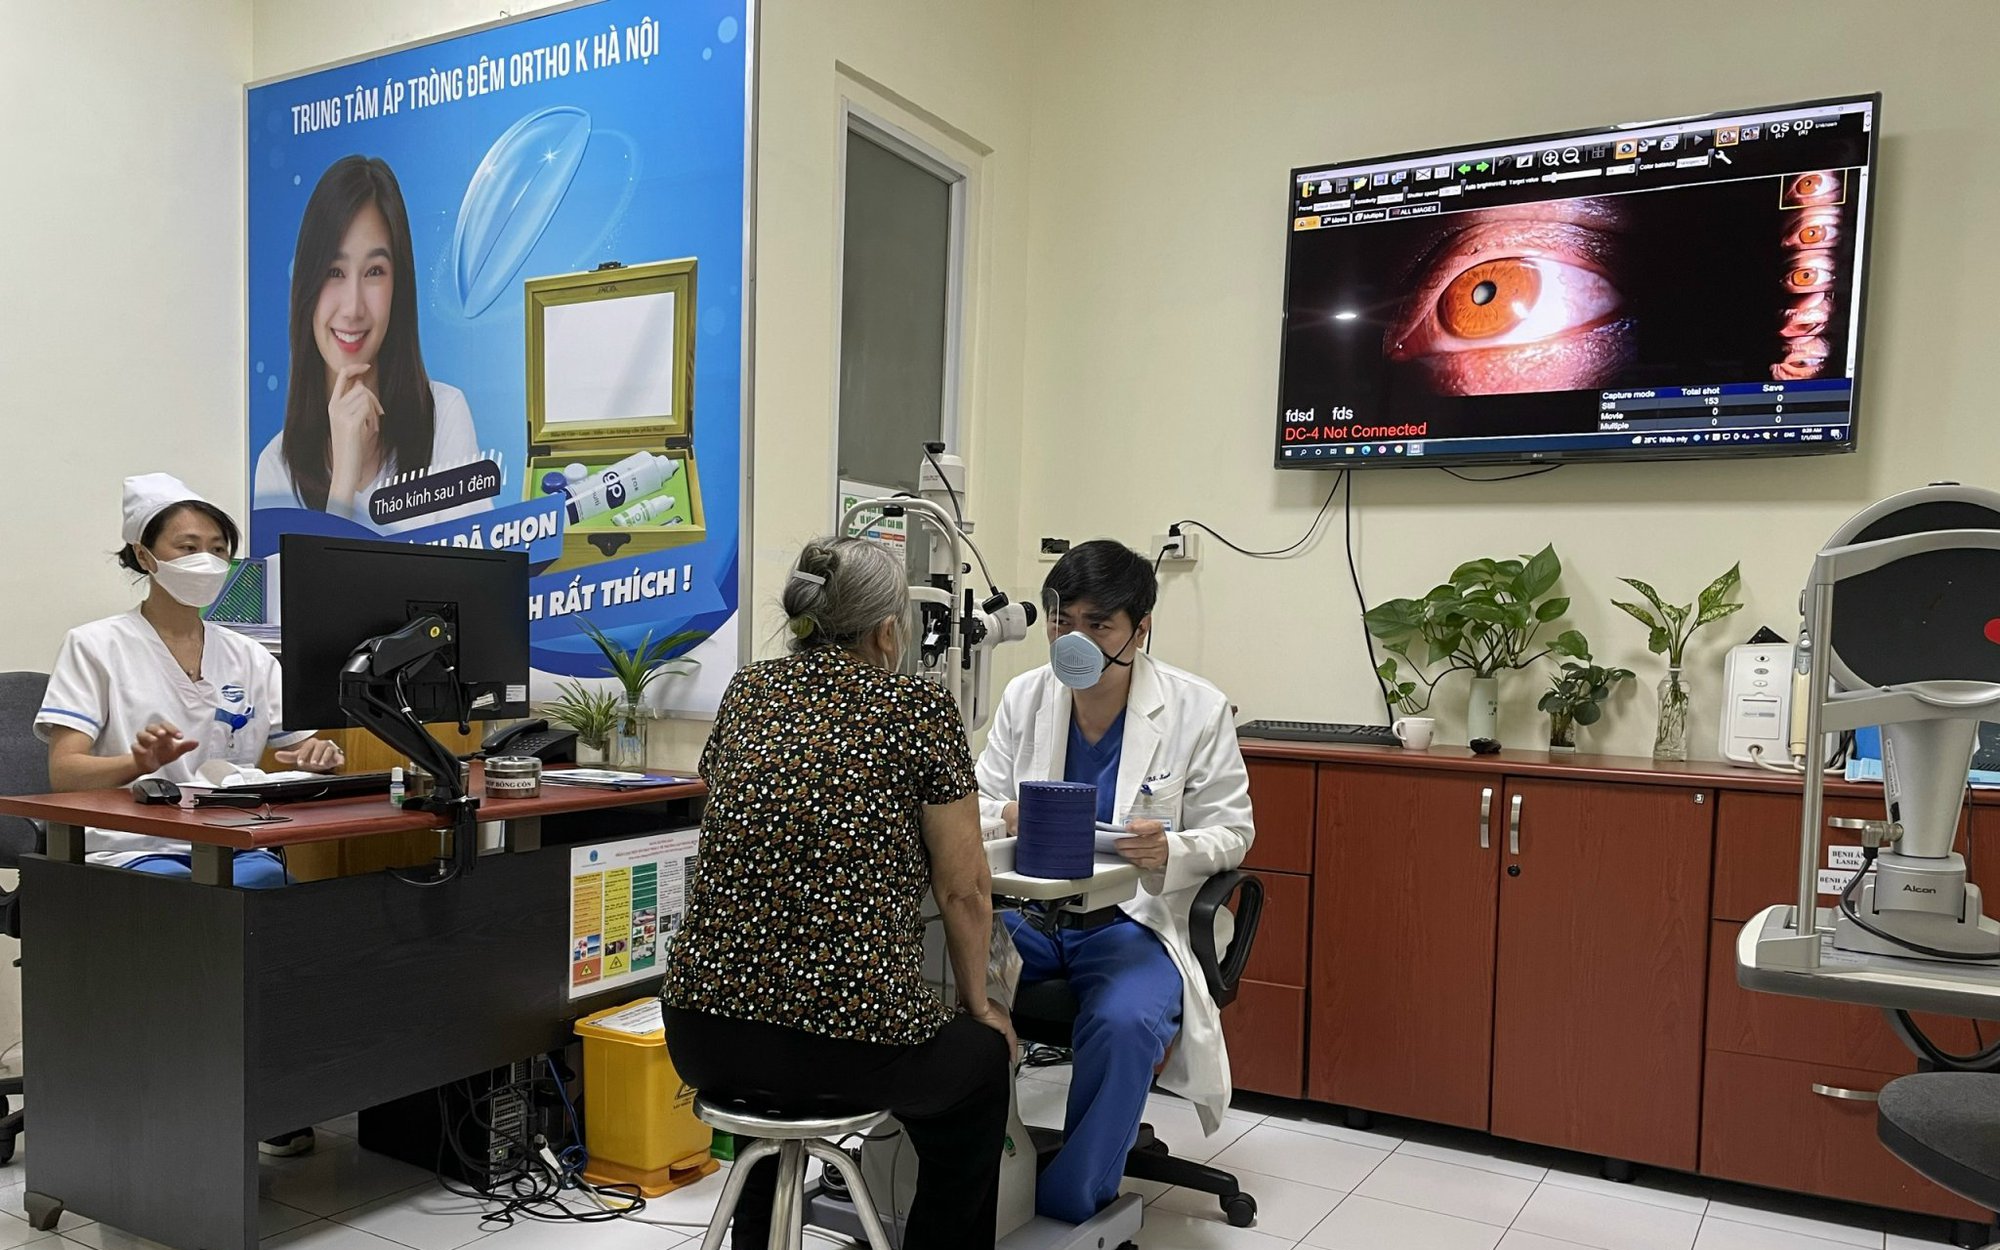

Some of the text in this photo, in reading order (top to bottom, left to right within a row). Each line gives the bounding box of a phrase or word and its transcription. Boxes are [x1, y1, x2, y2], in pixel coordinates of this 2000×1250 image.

[291, 16, 660, 135] TRUNG TÂM ÁP TRÒNG ĐÊM ORTHO K HÀ NỘI
[1770, 122, 1790, 134] OS
[1793, 119, 1814, 131] OD
[1412, 205, 1437, 214] IMAGES
[1681, 386, 1720, 396] Total shot
[1762, 384, 1784, 392] Save
[1602, 390, 1655, 401] Capture mode
[1776, 394, 1784, 402] 0
[1704, 397, 1719, 405] 153
[1601, 402, 1616, 410] Still
[1775, 404, 1783, 413] 0
[1285, 406, 1354, 422] fdsd fds
[1600, 412, 1624, 420] Movie
[1712, 407, 1719, 416] 0
[1711, 418, 1718, 426] 0
[1775, 415, 1782, 424] 0
[1600, 422, 1630, 431] Multiple
[1285, 422, 1427, 441] DC-4 Not Connected
[375, 474, 496, 515] Tháo kính sau 1 đêm
[489, 510, 558, 550] CHỌN
[549, 574, 596, 617] RẤT
[601, 566, 676, 607] THÍCH
[1902, 884, 1937, 894] Alcon
